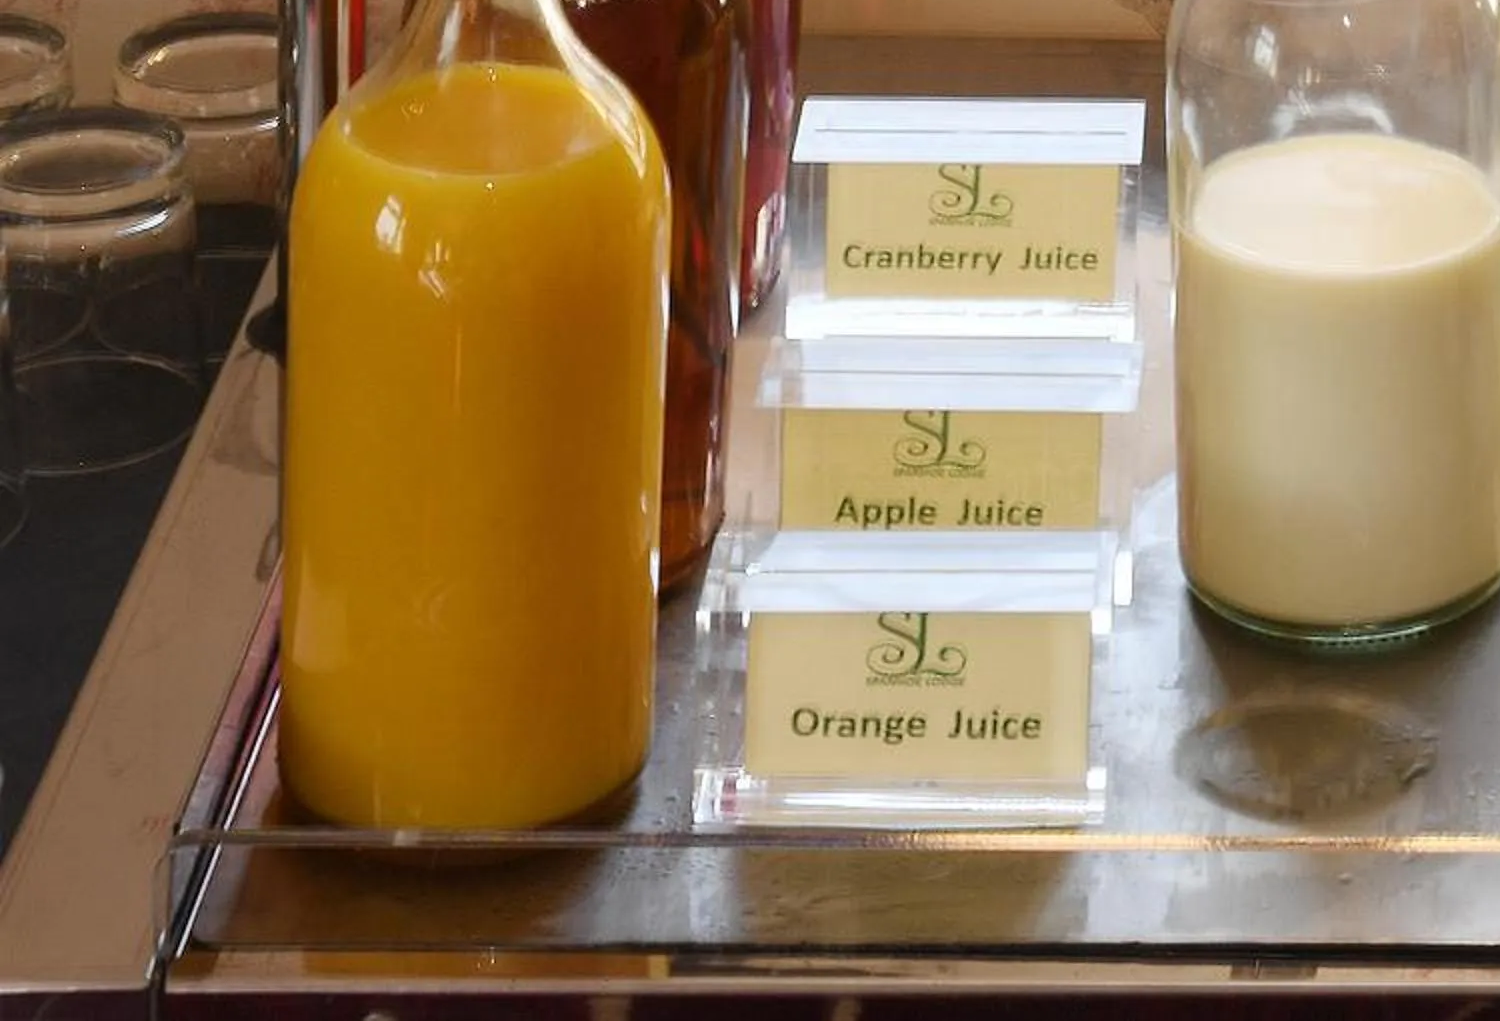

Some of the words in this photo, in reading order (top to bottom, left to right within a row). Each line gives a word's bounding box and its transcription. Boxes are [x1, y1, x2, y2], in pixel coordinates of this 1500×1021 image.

[843, 243, 1001, 275] Cranberry
[1020, 246, 1099, 271] Juice
[835, 496, 937, 530] Apple
[956, 498, 1044, 526] Juice
[791, 708, 927, 744] Orange
[947, 710, 1041, 740] Juice
